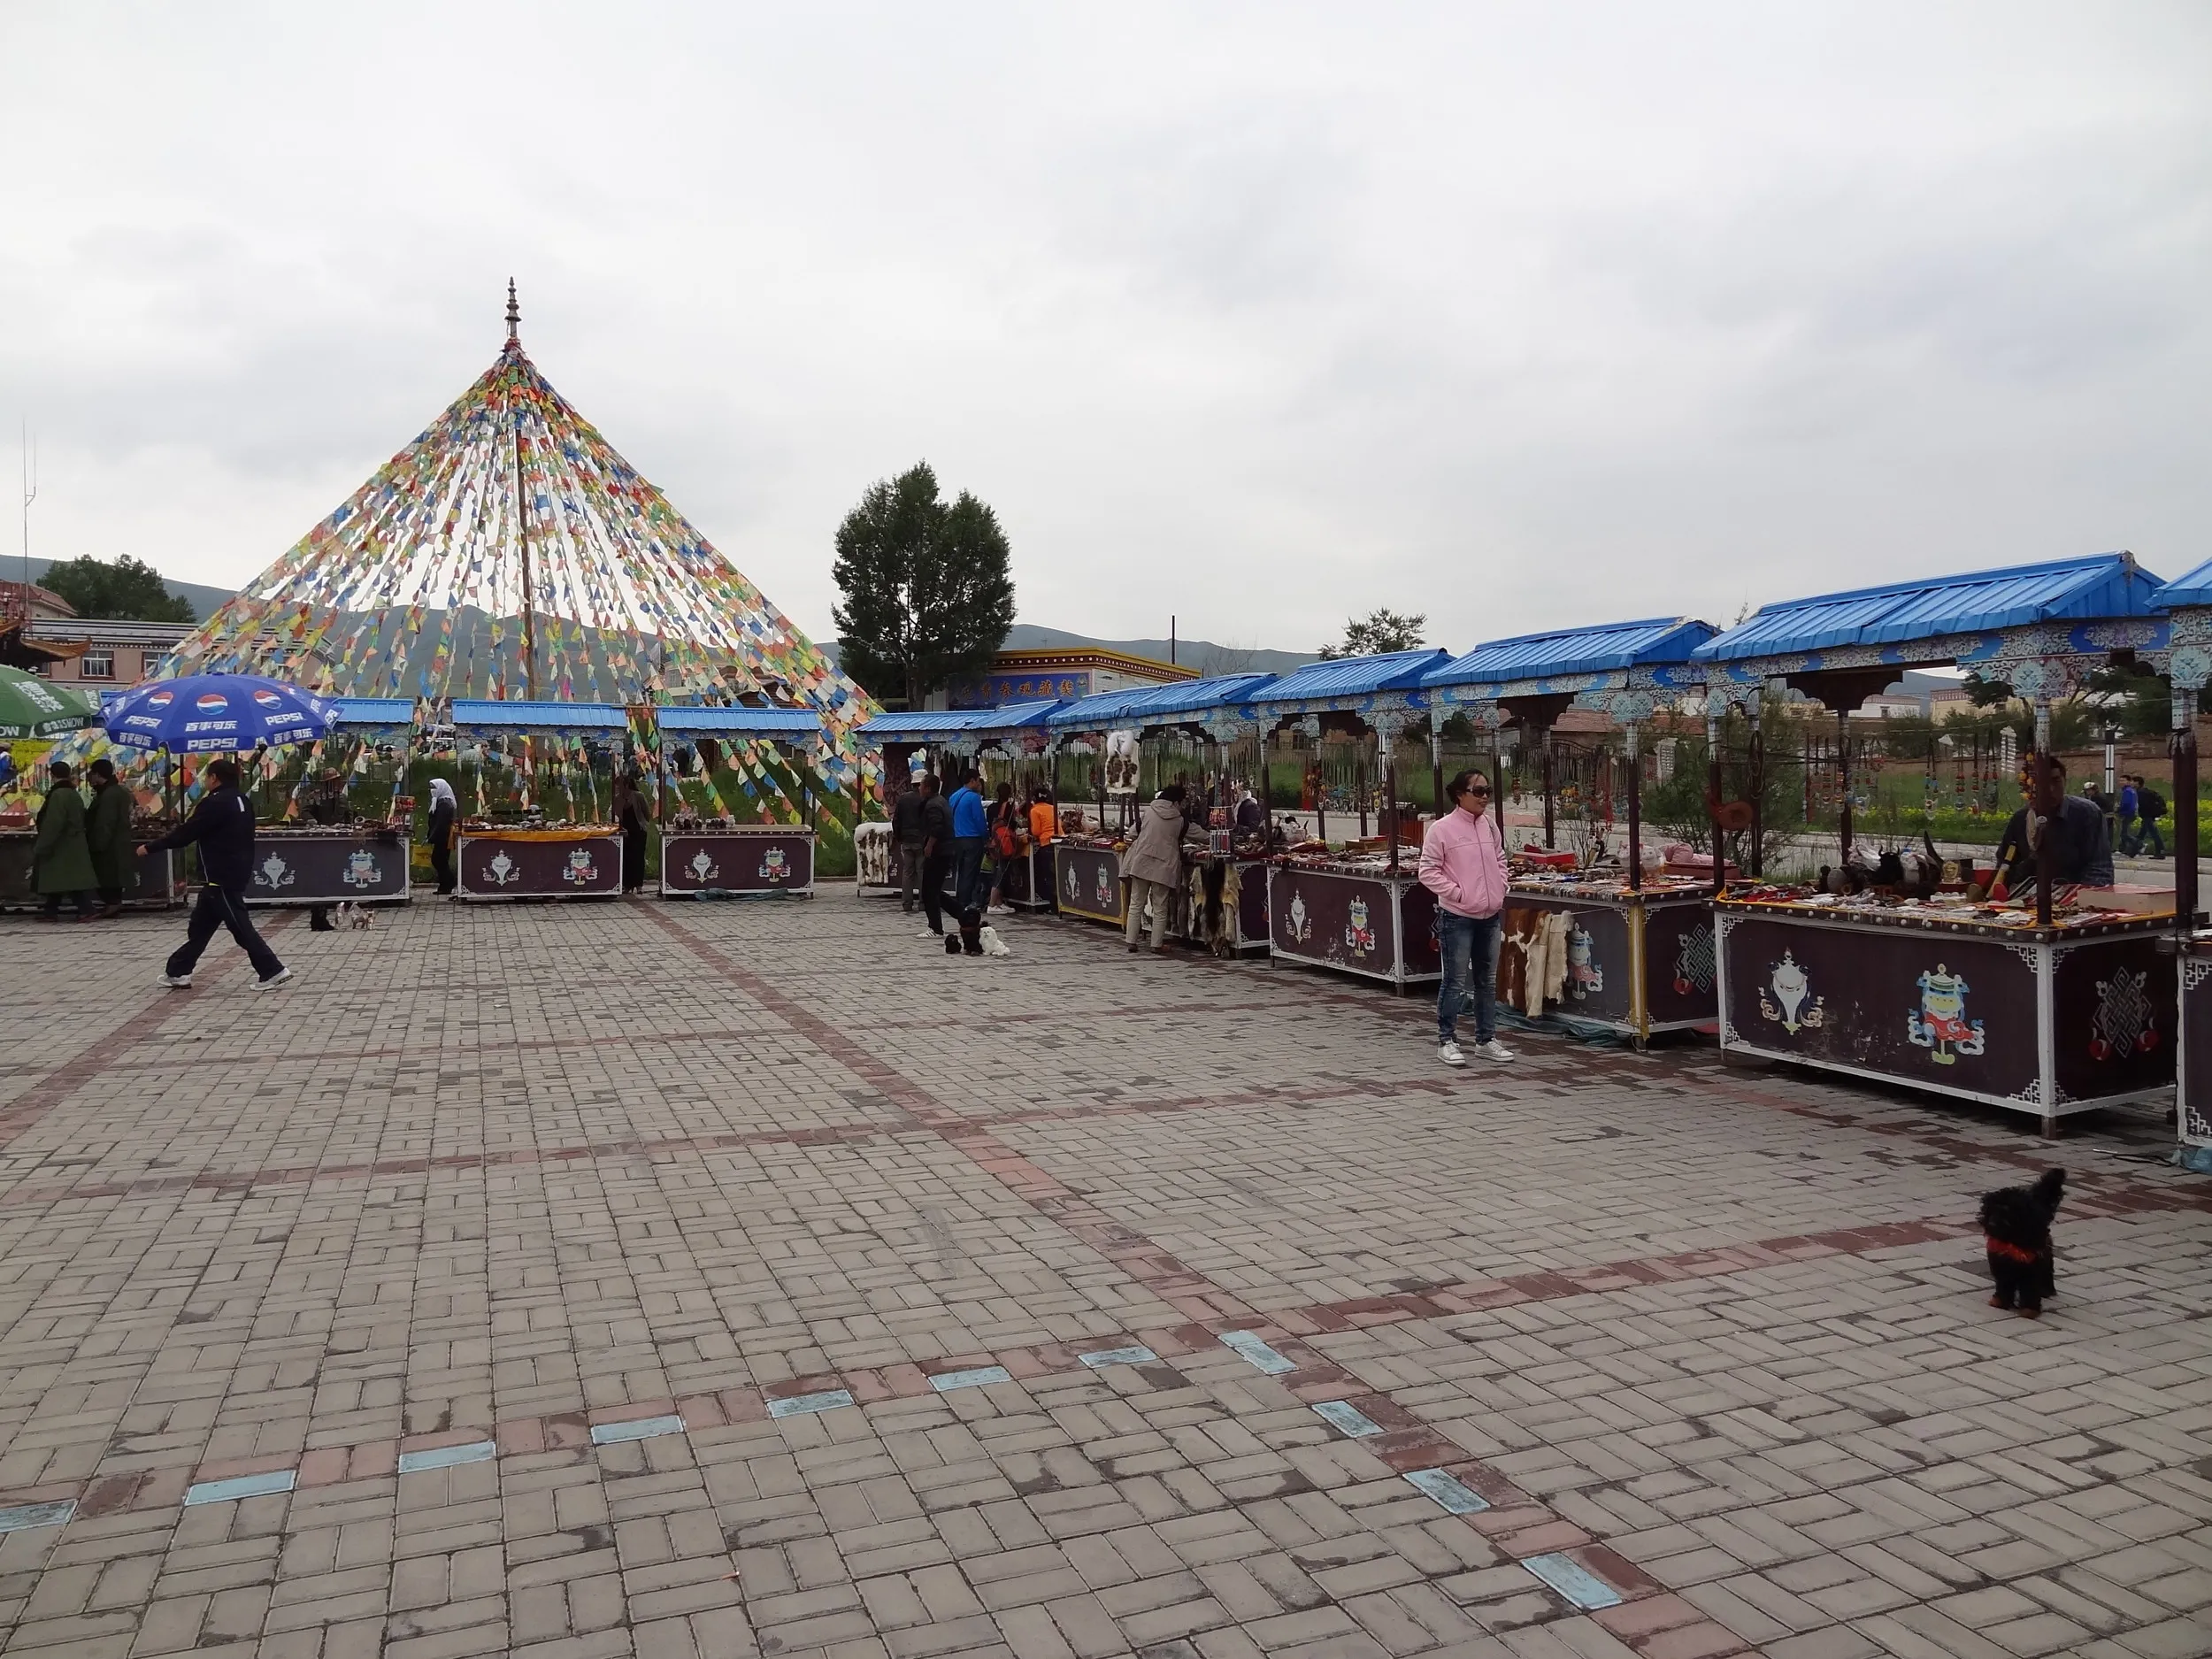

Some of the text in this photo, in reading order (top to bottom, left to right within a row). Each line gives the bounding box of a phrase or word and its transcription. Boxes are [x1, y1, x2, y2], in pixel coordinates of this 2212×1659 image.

[125, 715, 162, 729] PEPSI
[185, 720, 238, 732] 百事可乐
[265, 712, 304, 726] PEPSI
[119, 732, 152, 747] 百事可乐
[273, 728, 313, 744] 百事可乐
[187, 738, 239, 750] PEPSI
